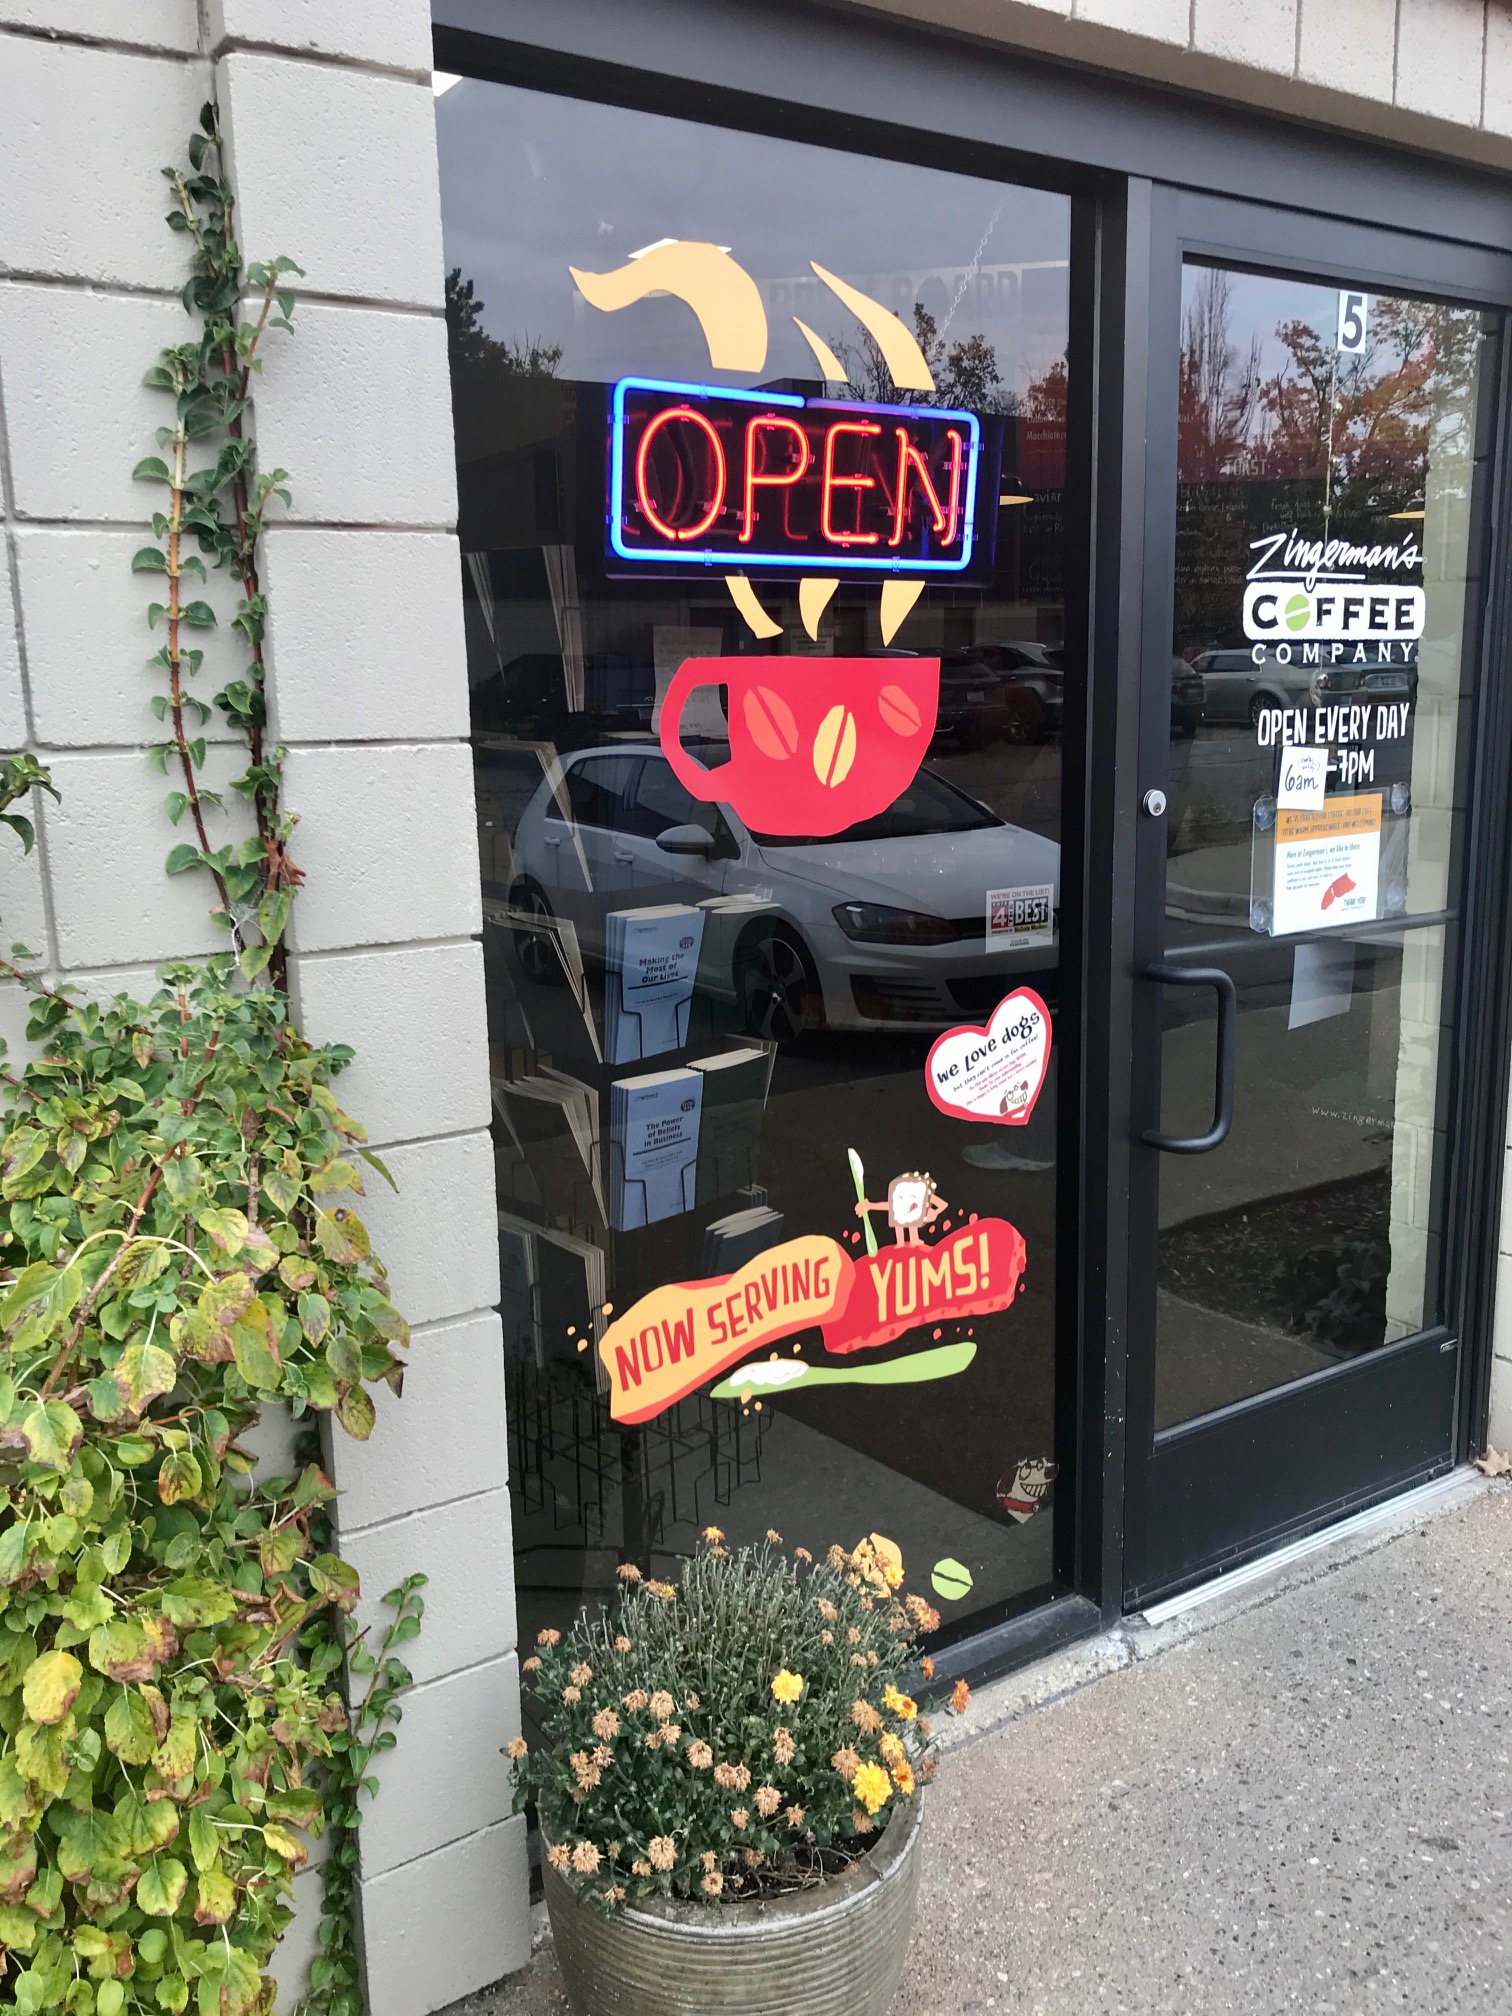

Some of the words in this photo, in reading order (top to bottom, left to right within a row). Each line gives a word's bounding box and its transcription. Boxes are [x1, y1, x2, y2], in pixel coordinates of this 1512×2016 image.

[1341, 295, 1363, 349] 5
[636, 405, 963, 547] OPEN
[1246, 528, 1424, 591] Zingerman's
[1252, 643, 1414, 664] COMPANY
[1257, 707, 1308, 746] OPEN
[1315, 705, 1371, 744] EVERY
[1376, 702, 1410, 740] DAY
[1284, 764, 1319, 791] 6am
[1022, 889, 1035, 897] THE
[992, 907, 1007, 926] 4
[1015, 897, 1048, 924] BEST
[639, 955, 670, 967] Making
[671, 952, 685, 962] the
[645, 964, 667, 975] Most
[668, 962, 678, 971] of
[641, 975, 658, 984] Our
[659, 971, 679, 981] Lives
[936, 1063, 960, 1083] we
[964, 1037, 998, 1073] Love
[1001, 1012, 1040, 1045] dogs
[645, 1122, 660, 1131] The
[661, 1115, 684, 1128] Power
[647, 1130, 656, 1139] of
[657, 1124, 681, 1137] Beliefs
[653, 1132, 683, 1145] Business
[614, 1308, 696, 1392] NOW
[707, 1256, 831, 1346] SERVING
[869, 1232, 990, 1323] YUMS!
